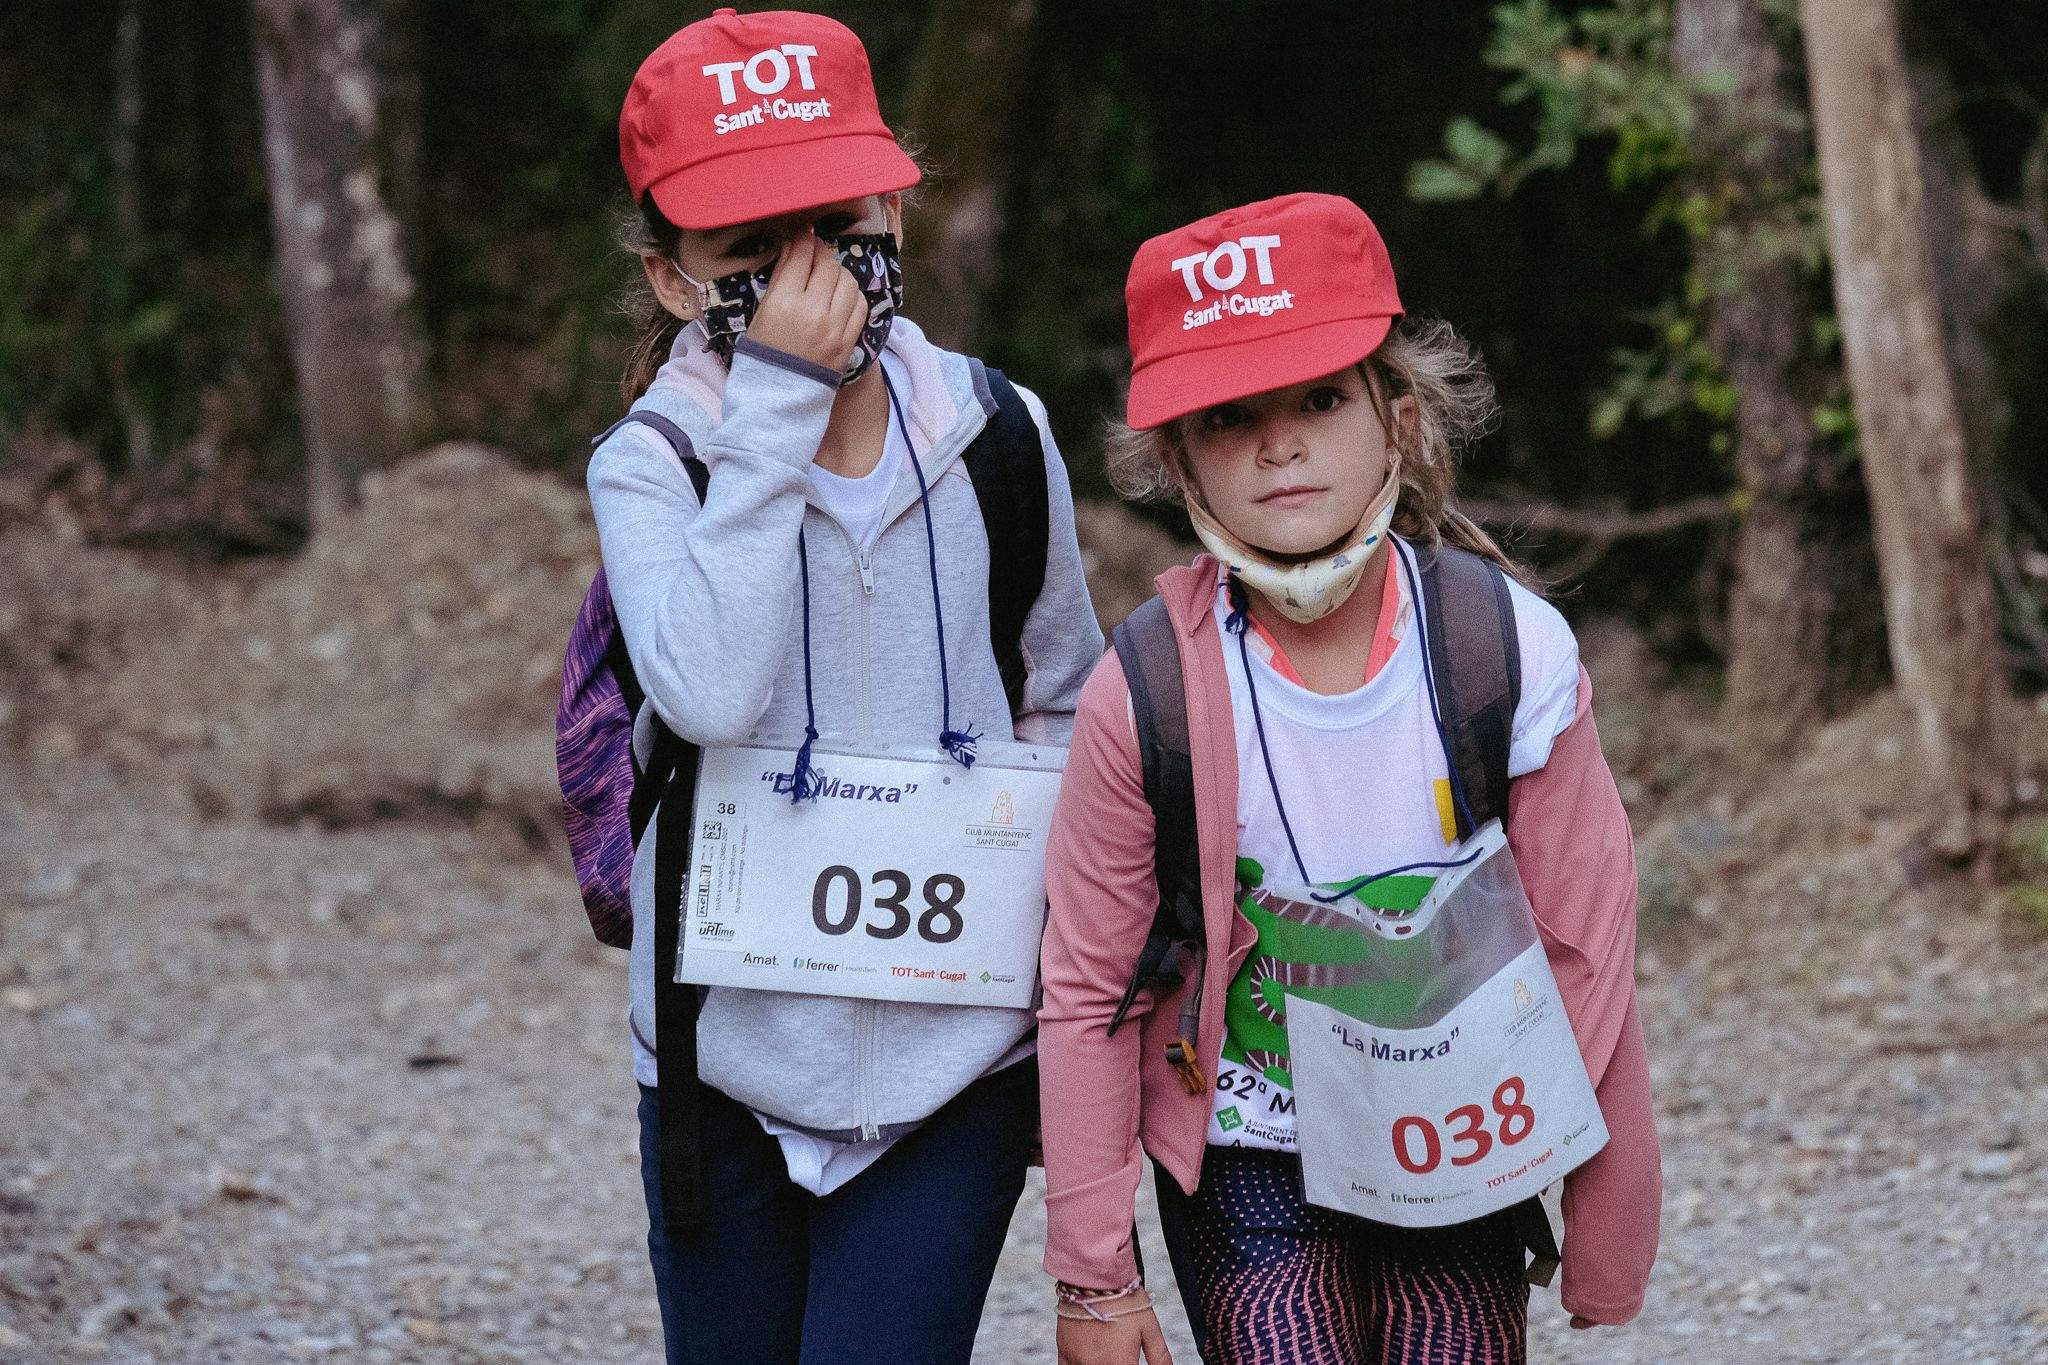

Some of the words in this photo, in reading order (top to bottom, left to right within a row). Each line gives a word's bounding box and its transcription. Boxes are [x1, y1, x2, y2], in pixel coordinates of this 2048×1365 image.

[702, 44, 819, 106] TOT
[713, 104, 765, 135] Sant
[772, 97, 832, 122] Cugat
[1171, 234, 1281, 302] TOT
[1182, 301, 1223, 331] Sant
[1229, 289, 1295, 317] Cugat
[716, 802, 736, 815] 38
[965, 828, 982, 836] CLUB
[983, 829, 1033, 840] MUNTANYENC
[976, 838, 994, 846] SANT
[995, 840, 1019, 848] CUGAT
[811, 864, 967, 945] 038
[890, 966, 913, 978] TOT
[913, 968, 936, 980] Sant
[939, 970, 968, 983] Cugat
[1243, 1124, 1298, 1145] SantCugat
[1391, 1075, 1536, 1175] 038
[1486, 1173, 1507, 1190] TOT
[1507, 1165, 1528, 1181] Sant
[1530, 1147, 1554, 1169] Cugat
[1402, 1191, 1436, 1205] ferrer
